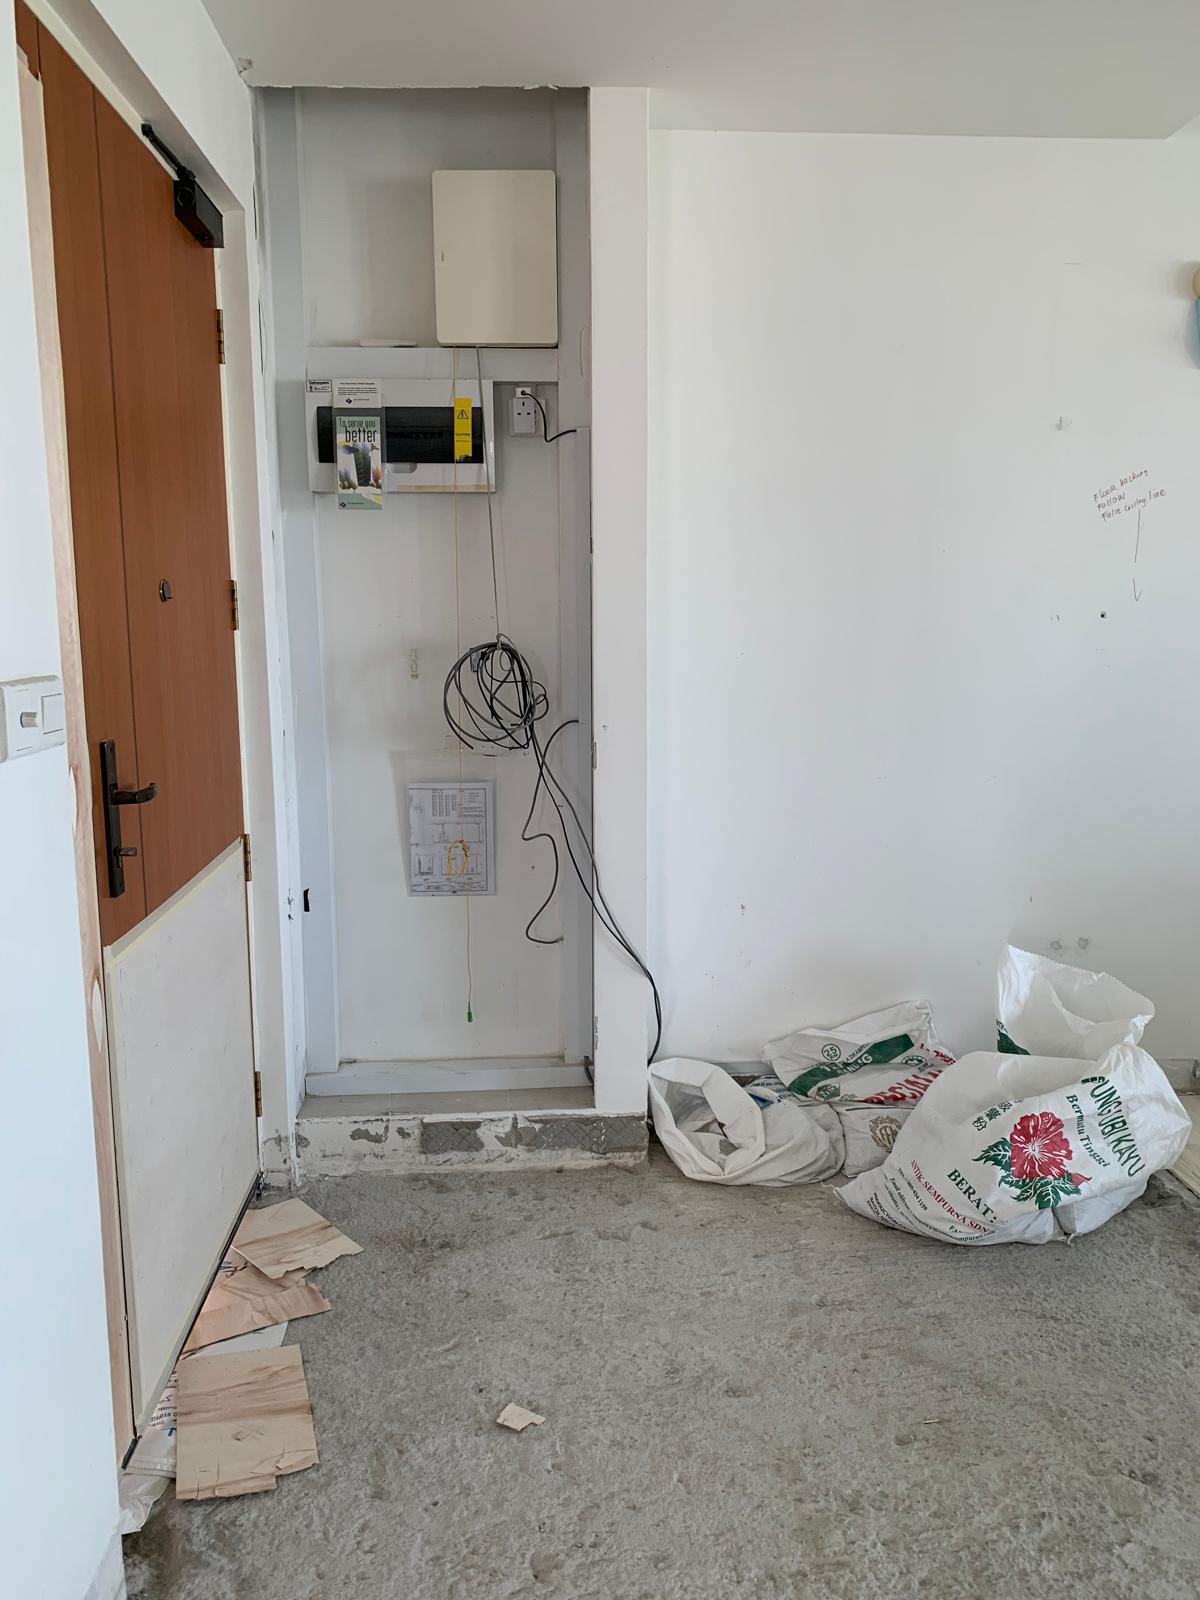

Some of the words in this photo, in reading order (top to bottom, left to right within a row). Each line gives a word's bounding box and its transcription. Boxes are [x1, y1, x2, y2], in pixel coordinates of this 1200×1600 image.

[345, 426, 377, 443] better
[364, 420, 376, 429] you
[1080, 1135, 1110, 1167] Tinggi
[922, 1180, 967, 1225] SEMPURNA
